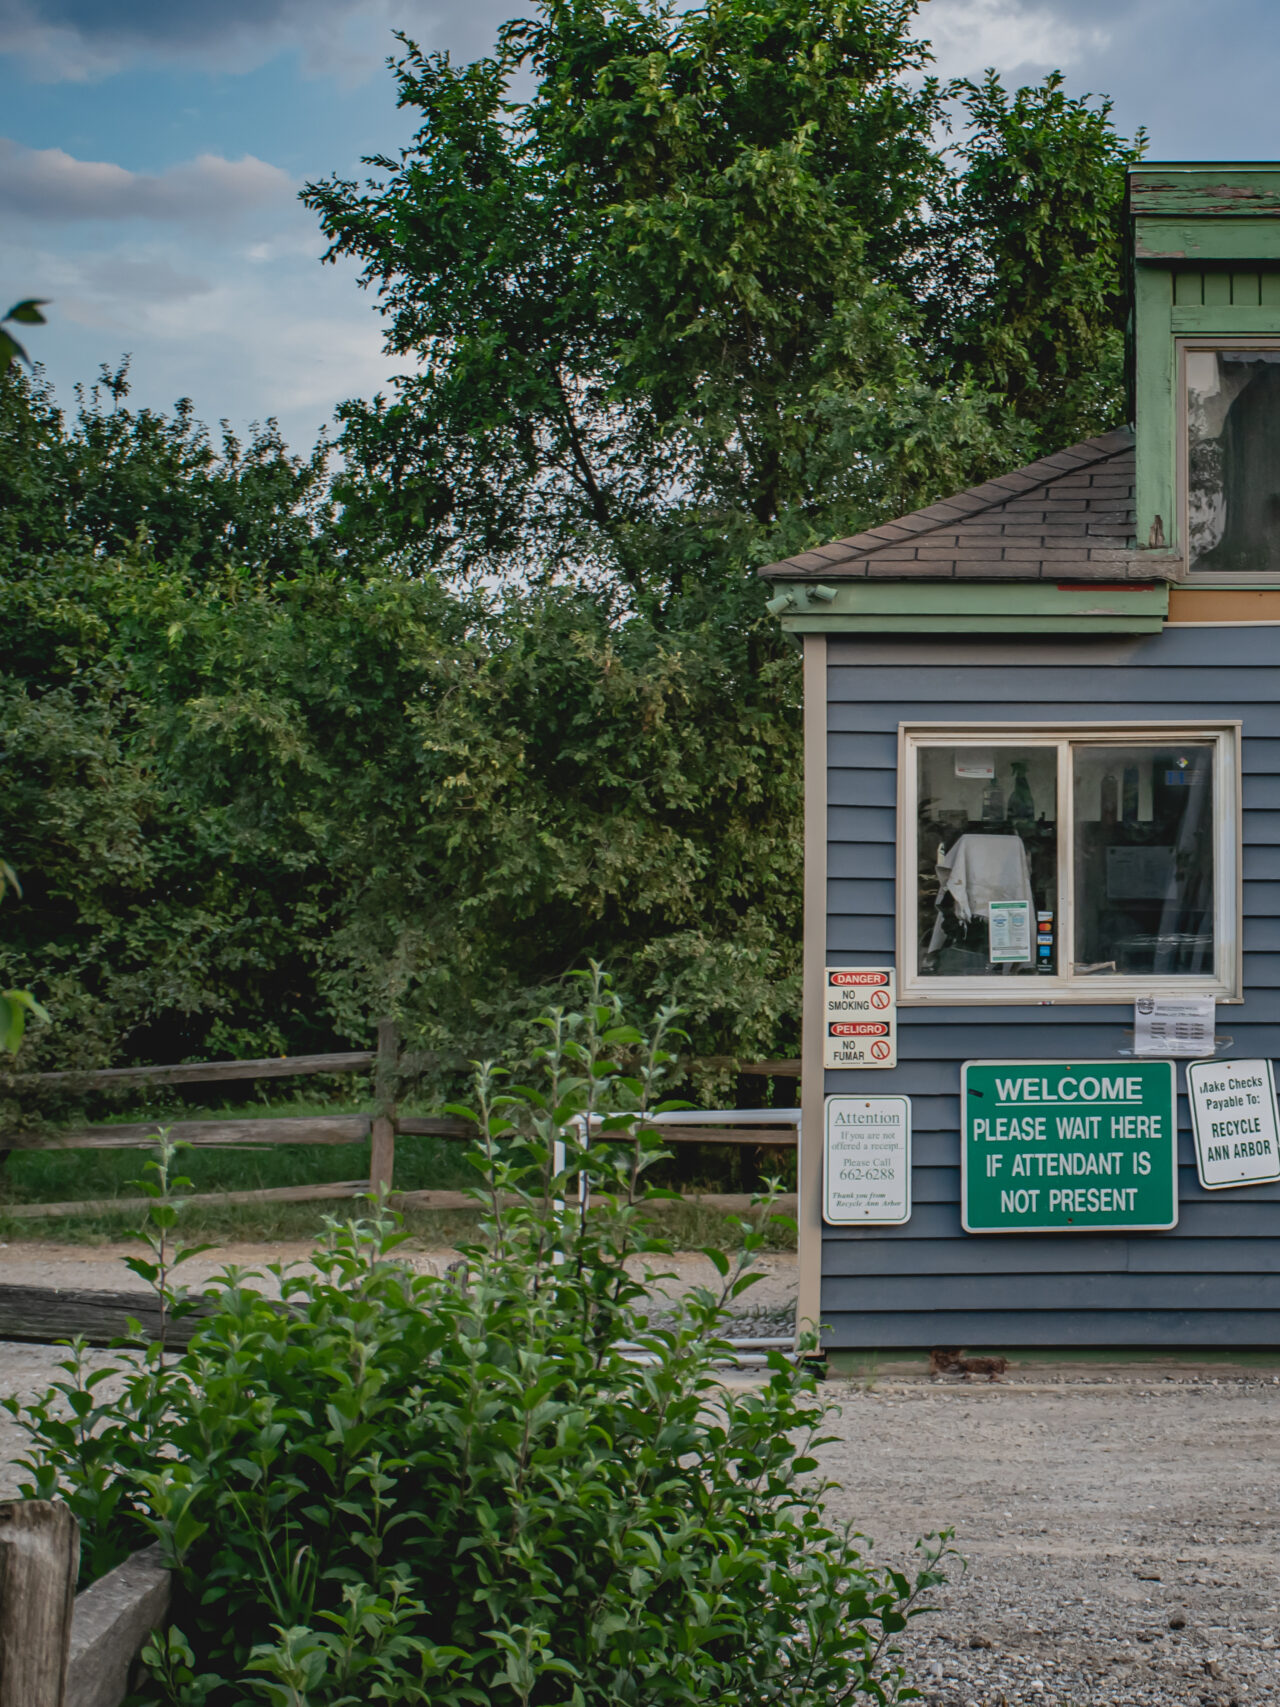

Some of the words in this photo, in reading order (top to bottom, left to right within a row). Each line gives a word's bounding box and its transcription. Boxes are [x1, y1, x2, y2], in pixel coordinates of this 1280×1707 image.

[837, 975, 881, 983] DANGER
[843, 991, 855, 999] NO
[828, 1001, 869, 1010] SMOKING
[837, 1025, 882, 1033] PELIGRO
[843, 1041, 855, 1049] NO
[834, 1052, 864, 1060] FUMAR
[995, 1077, 1143, 1101] WELCOME
[1229, 1077, 1263, 1090] Checks
[1206, 1095, 1244, 1111] Payable
[1246, 1094, 1260, 1105] To:
[835, 1111, 900, 1123] Attention
[973, 1118, 1046, 1141] PLEASE
[1056, 1117, 1103, 1140] WAIT
[1111, 1116, 1162, 1139] HERE
[1212, 1118, 1261, 1138] RECYCLE
[850, 1133, 864, 1141] you
[832, 1142, 860, 1150] offered
[1208, 1145, 1230, 1162] ANN
[1234, 1140, 1271, 1158] ARBOR
[986, 1154, 1002, 1177] IF
[1012, 1152, 1123, 1176] ATTENDANT
[1133, 1152, 1151, 1174] IS
[840, 1169, 894, 1180] 662-6288
[1001, 1190, 1039, 1213] NOT
[1049, 1188, 1138, 1212] PRESENT
